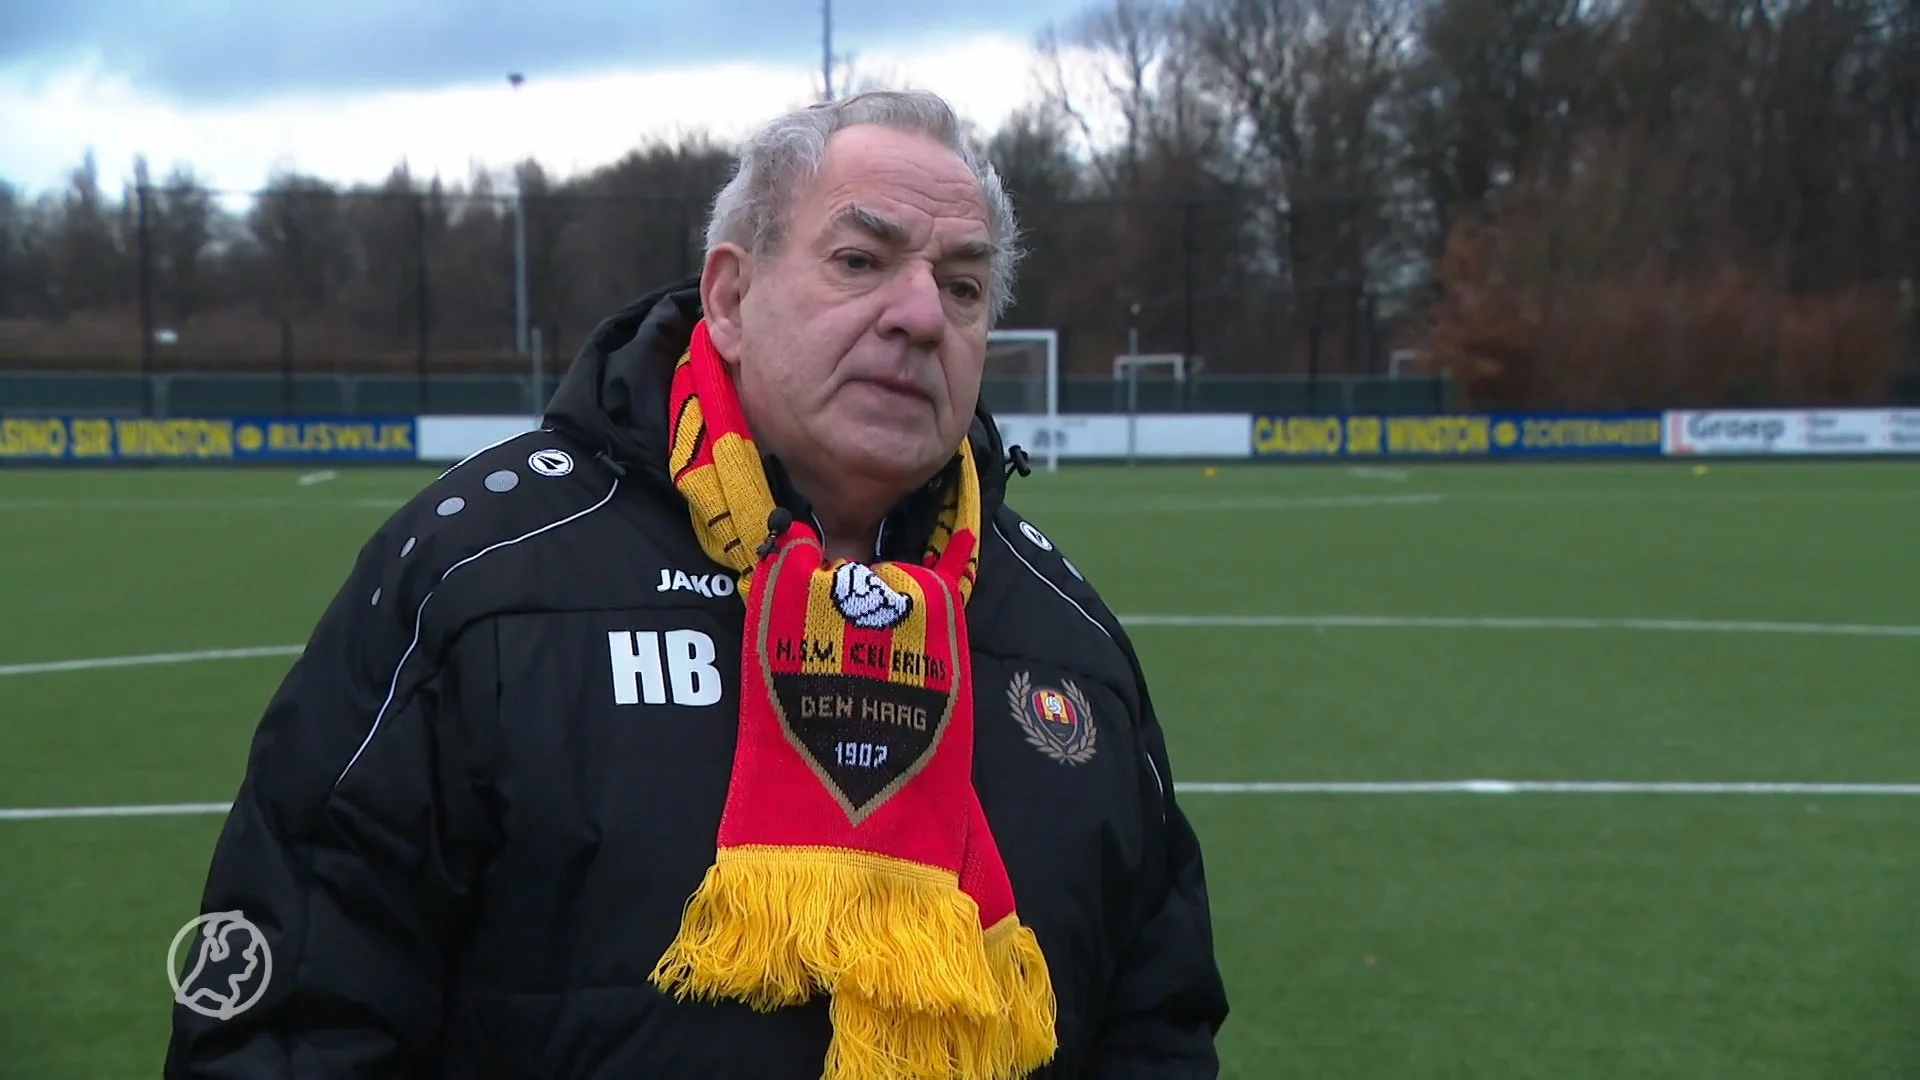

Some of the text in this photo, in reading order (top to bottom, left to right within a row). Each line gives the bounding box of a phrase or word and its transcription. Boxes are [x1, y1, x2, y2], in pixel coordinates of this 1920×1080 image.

[72, 418, 112, 456] SIR
[117, 418, 233, 457] WINSTON
[267, 422, 412, 451] RIJSWIJK
[1254, 416, 1489, 454] CASINO SIR WINSTON
[1687, 411, 1785, 452] Groep
[656, 568, 735, 598] JAKO
[607, 629, 723, 706] HB
[850, 642, 946, 681] CELERITAS
[801, 694, 928, 731] DEN HAAG
[834, 741, 889, 769] 1907
